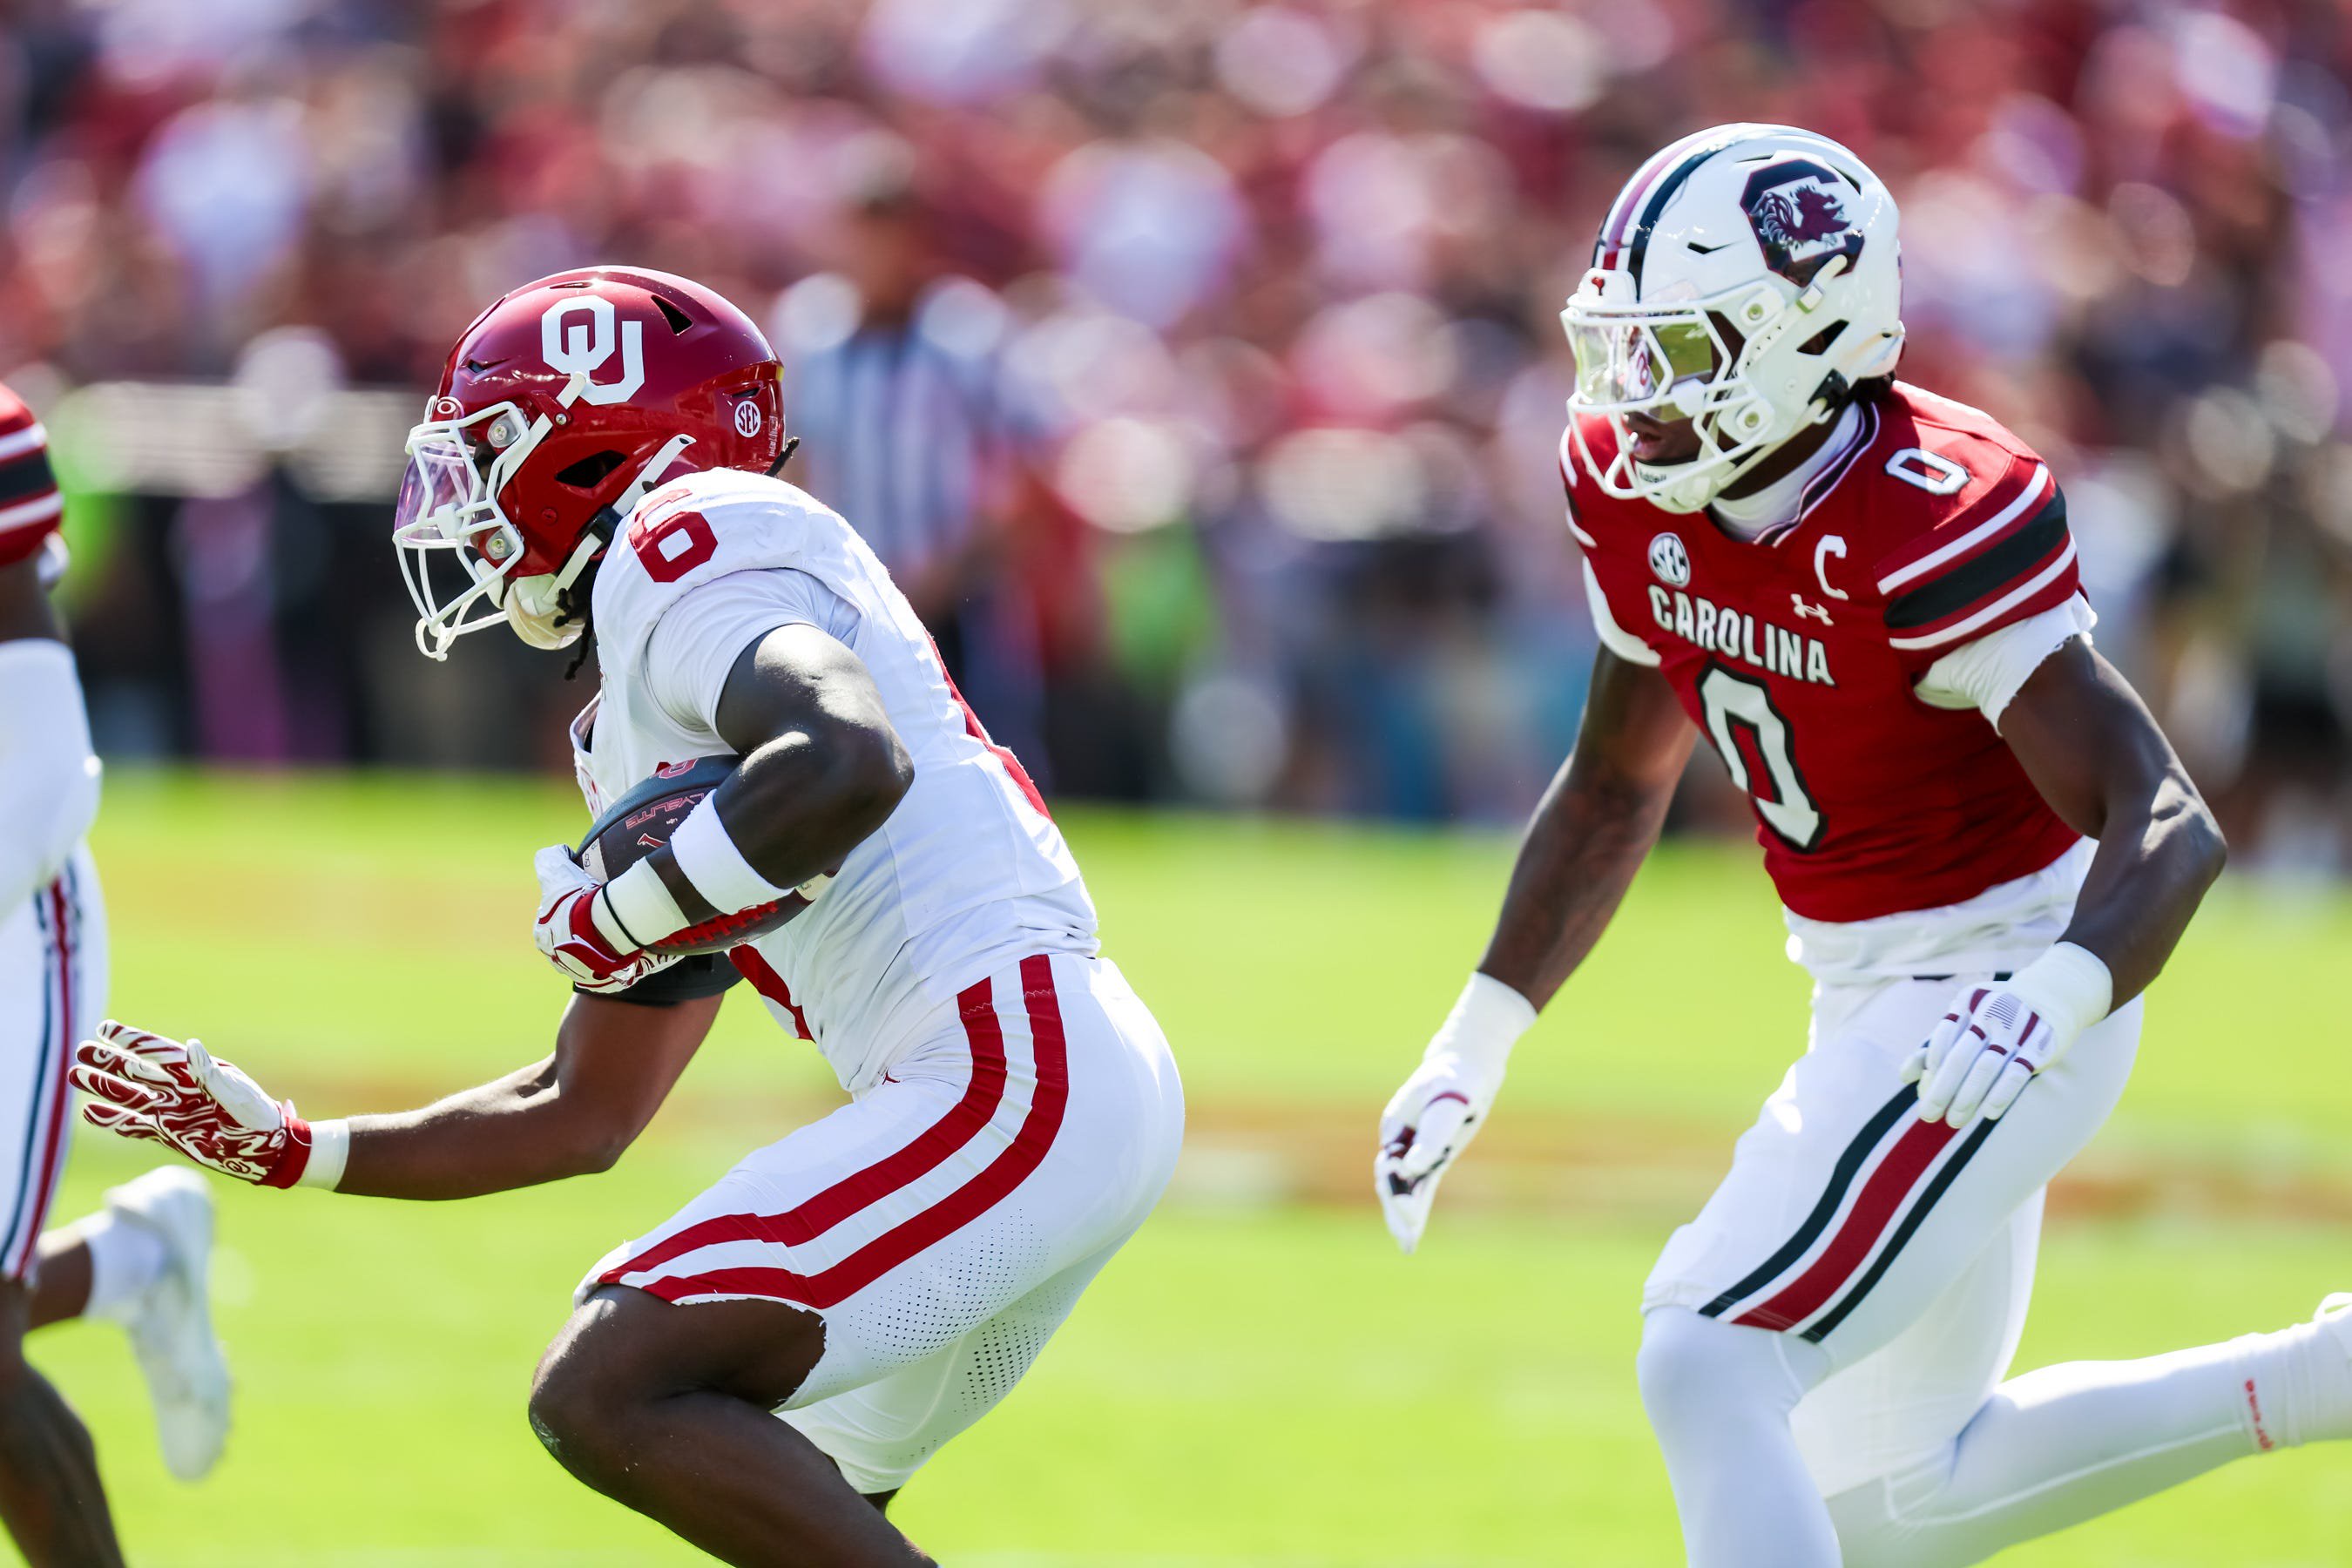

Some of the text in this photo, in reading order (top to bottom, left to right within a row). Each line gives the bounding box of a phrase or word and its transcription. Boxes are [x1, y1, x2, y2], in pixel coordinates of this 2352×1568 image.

[542, 294, 645, 406] OU
[737, 403, 759, 435] SEC
[628, 488, 718, 583] 6
[1651, 535, 1688, 585] SEC
[1814, 534, 1848, 600] C
[1647, 584, 1836, 686] CAROLINA
[1697, 657, 1828, 853] 0
[625, 793, 705, 830] LYELITE
